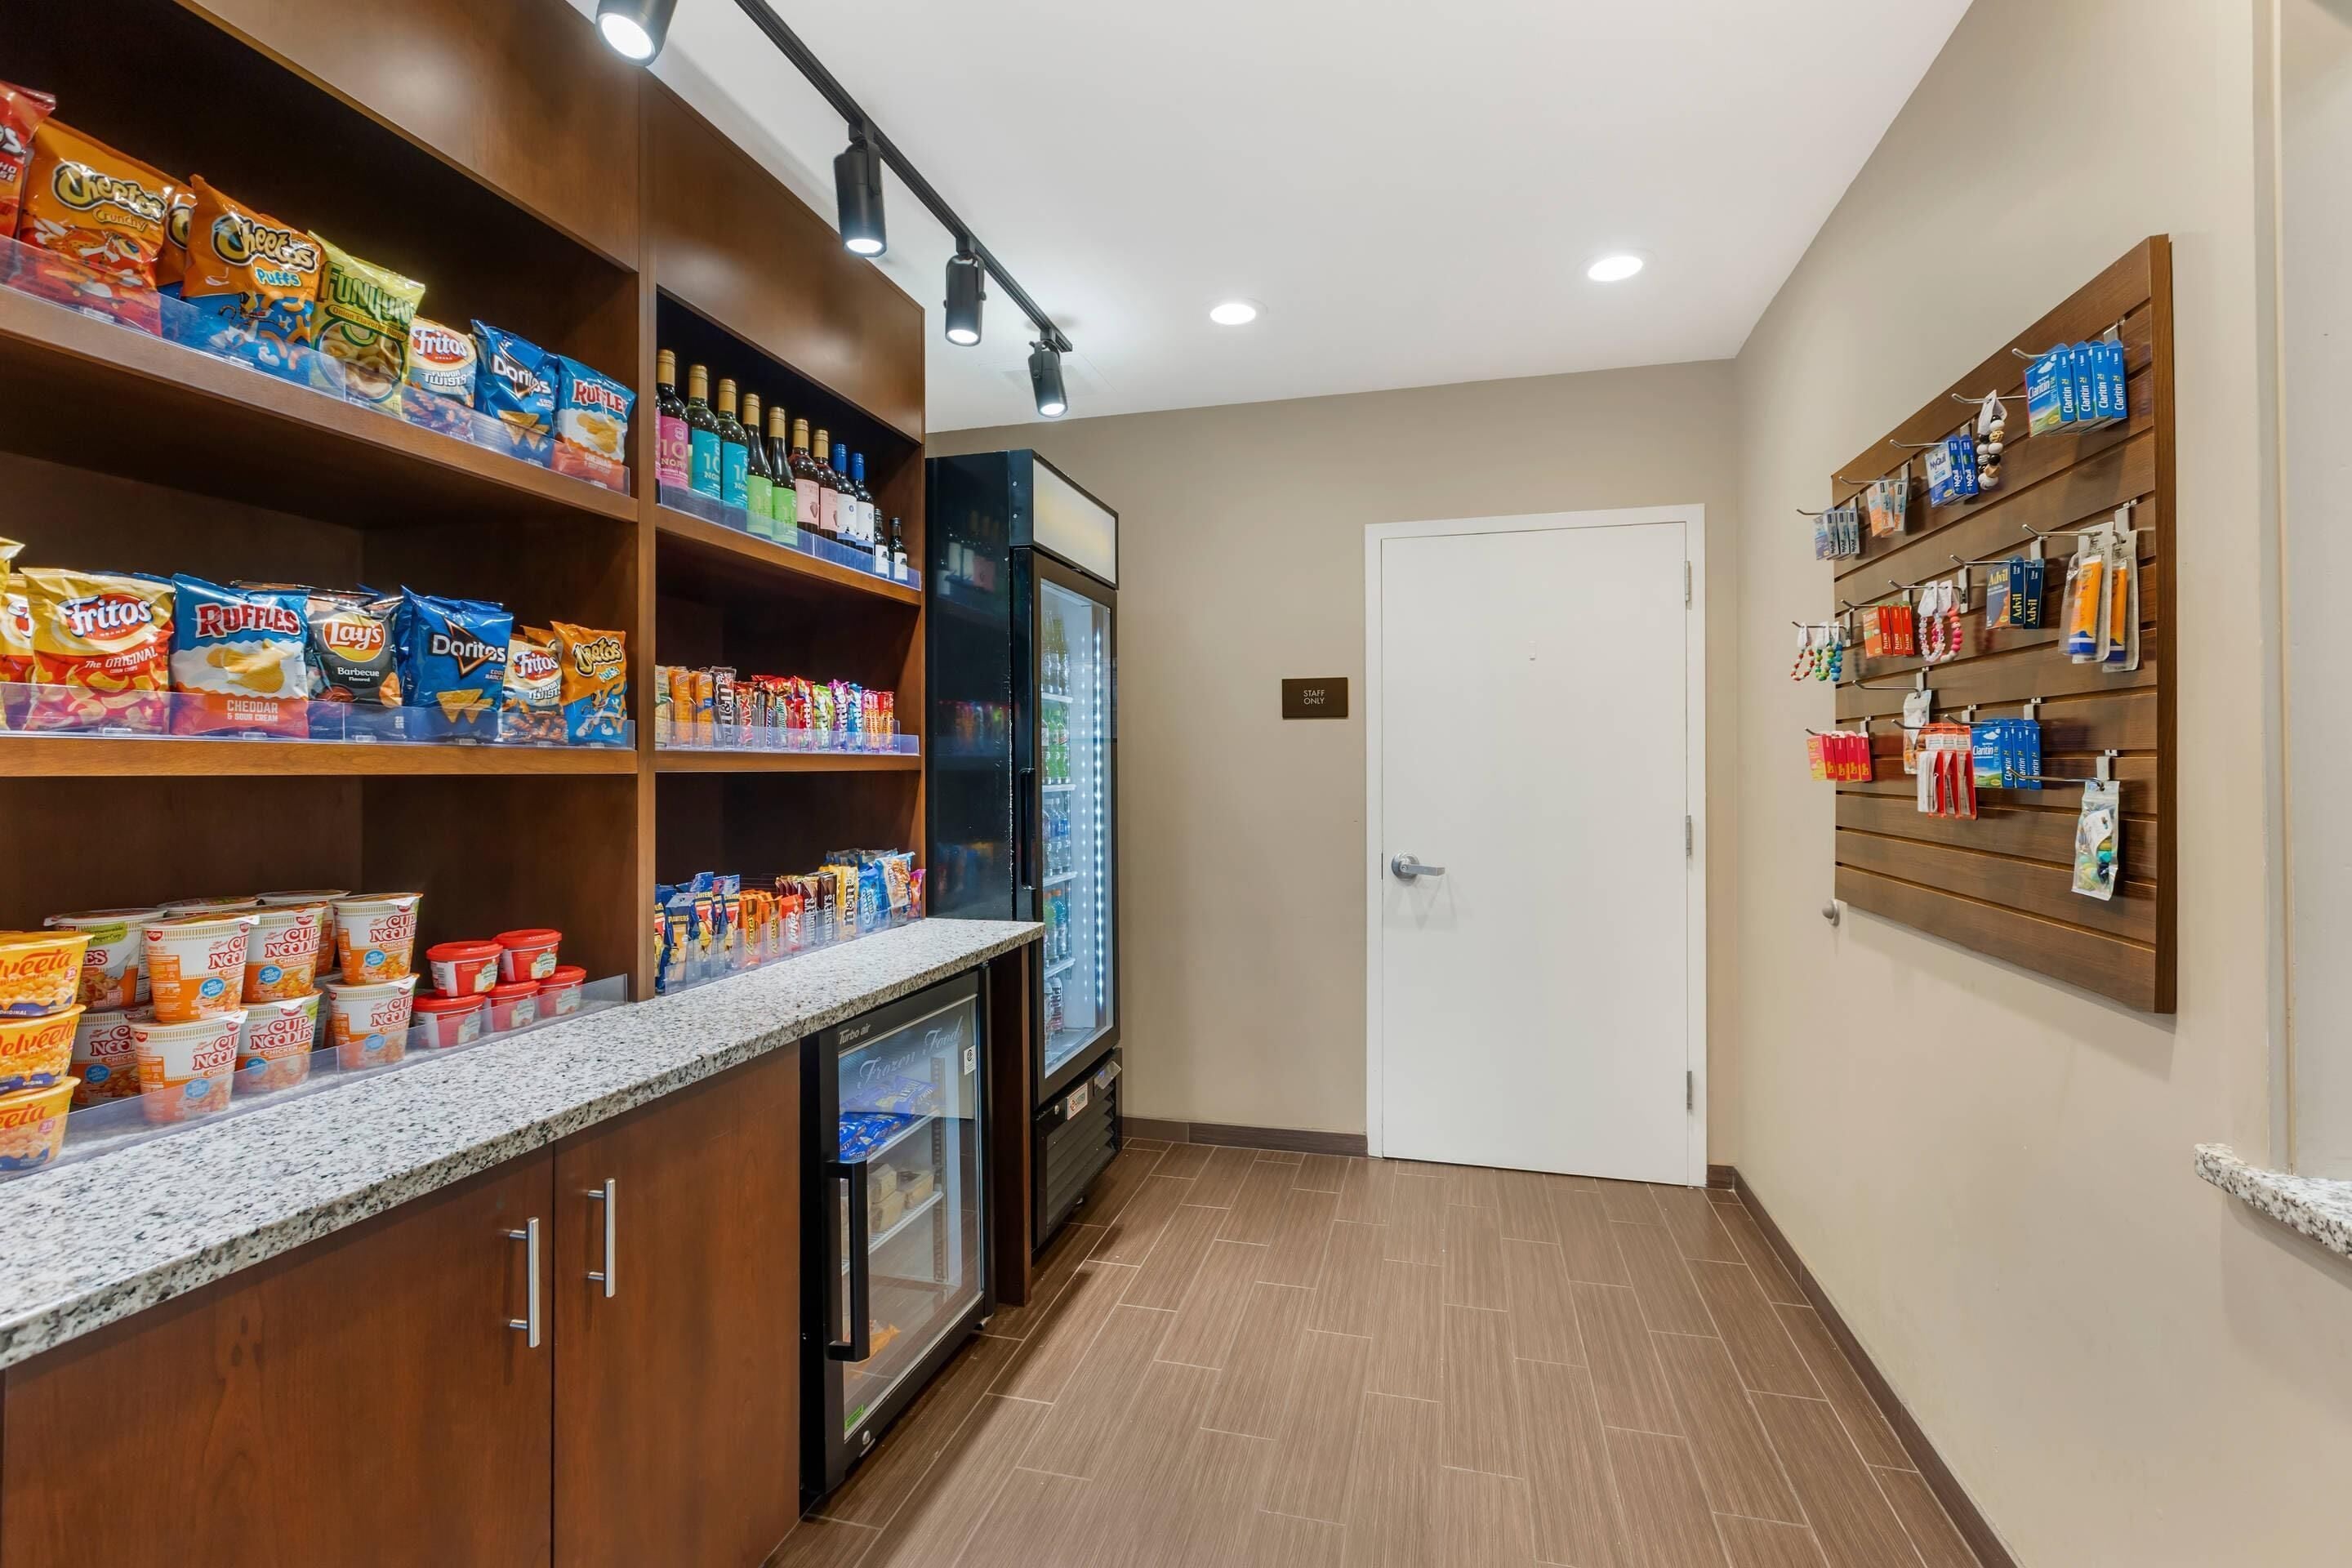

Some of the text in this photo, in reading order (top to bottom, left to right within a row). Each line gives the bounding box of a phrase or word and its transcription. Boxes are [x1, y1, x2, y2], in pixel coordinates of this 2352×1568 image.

[53, 162, 167, 223] Cheetos
[93, 207, 149, 232] Crunchy
[255, 268, 301, 287] Puffs
[410, 327, 468, 357] Fritos
[2062, 386, 2074, 413] Claritin
[2080, 385, 2091, 412] Claritin
[2098, 381, 2109, 408] Claritin
[2114, 383, 2124, 410] Claritin
[1988, 568, 2008, 586] Advil
[58, 595, 154, 638] Fritos
[2012, 594, 2022, 619] Advil
[2027, 599, 2038, 625] Advil
[195, 603, 301, 638] RUFFLES
[329, 621, 382, 650] Lay's
[432, 634, 506, 662] Doritos
[84, 645, 158, 669] The ORIGINAL
[512, 650, 559, 678] Fritos
[337, 666, 380, 678] Barbecue
[226, 699, 278, 713] CHEDDAR
[234, 713, 253, 721] SOUR
[255, 713, 278, 722] CREAM
[1972, 744, 1993, 755] Claritin
[283, 926, 320, 943] CUP
[386, 915, 415, 929] CUP
[250, 1025, 314, 1050] NOODLES
[268, 1017, 309, 1035] CUP
[839, 1022, 871, 1045] Turbo air
[264, 1046, 298, 1056] CHICKEN
[858, 1051, 915, 1086] Frozen
